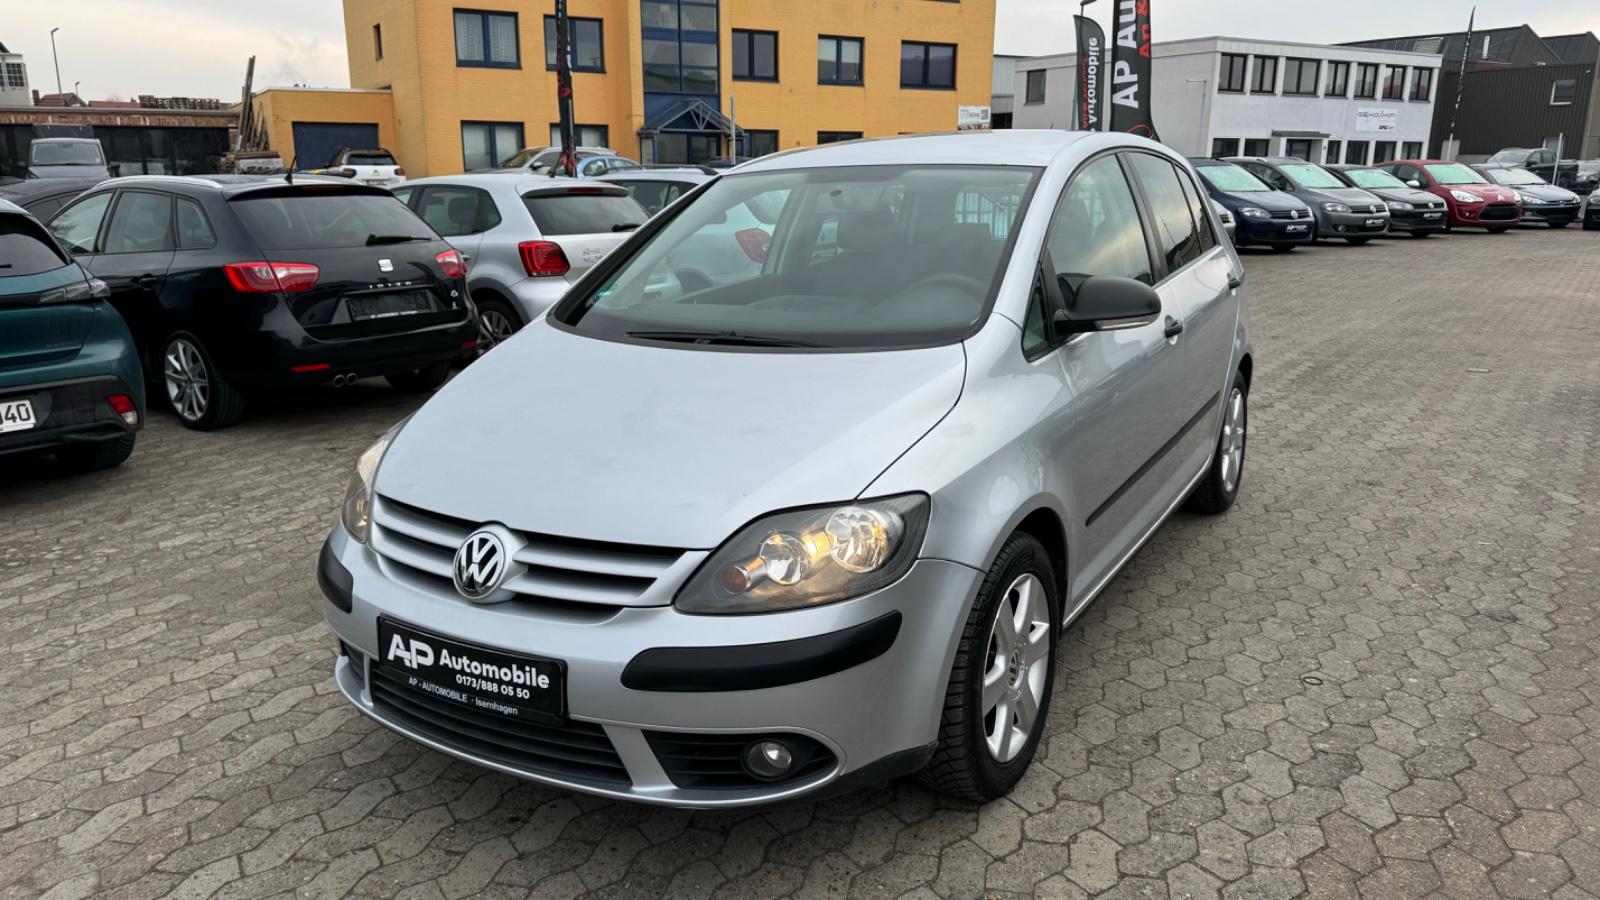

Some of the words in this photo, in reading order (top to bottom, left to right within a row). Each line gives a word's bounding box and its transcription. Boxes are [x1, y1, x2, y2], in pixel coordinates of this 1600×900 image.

[1139, 24, 1151, 59] An
[1112, 61, 1139, 109] AP
[0, 404, 31, 425] 40
[387, 633, 434, 670] AP
[439, 649, 550, 689] Automobile
[408, 677, 418, 686] AP
[422, 682, 467, 703] AUTOMOBILE
[475, 698, 518, 716] Isernhagen
[456, 674, 498, 692] 0173/888
[500, 685, 514, 697] 05
[516, 688, 530, 700] 50
